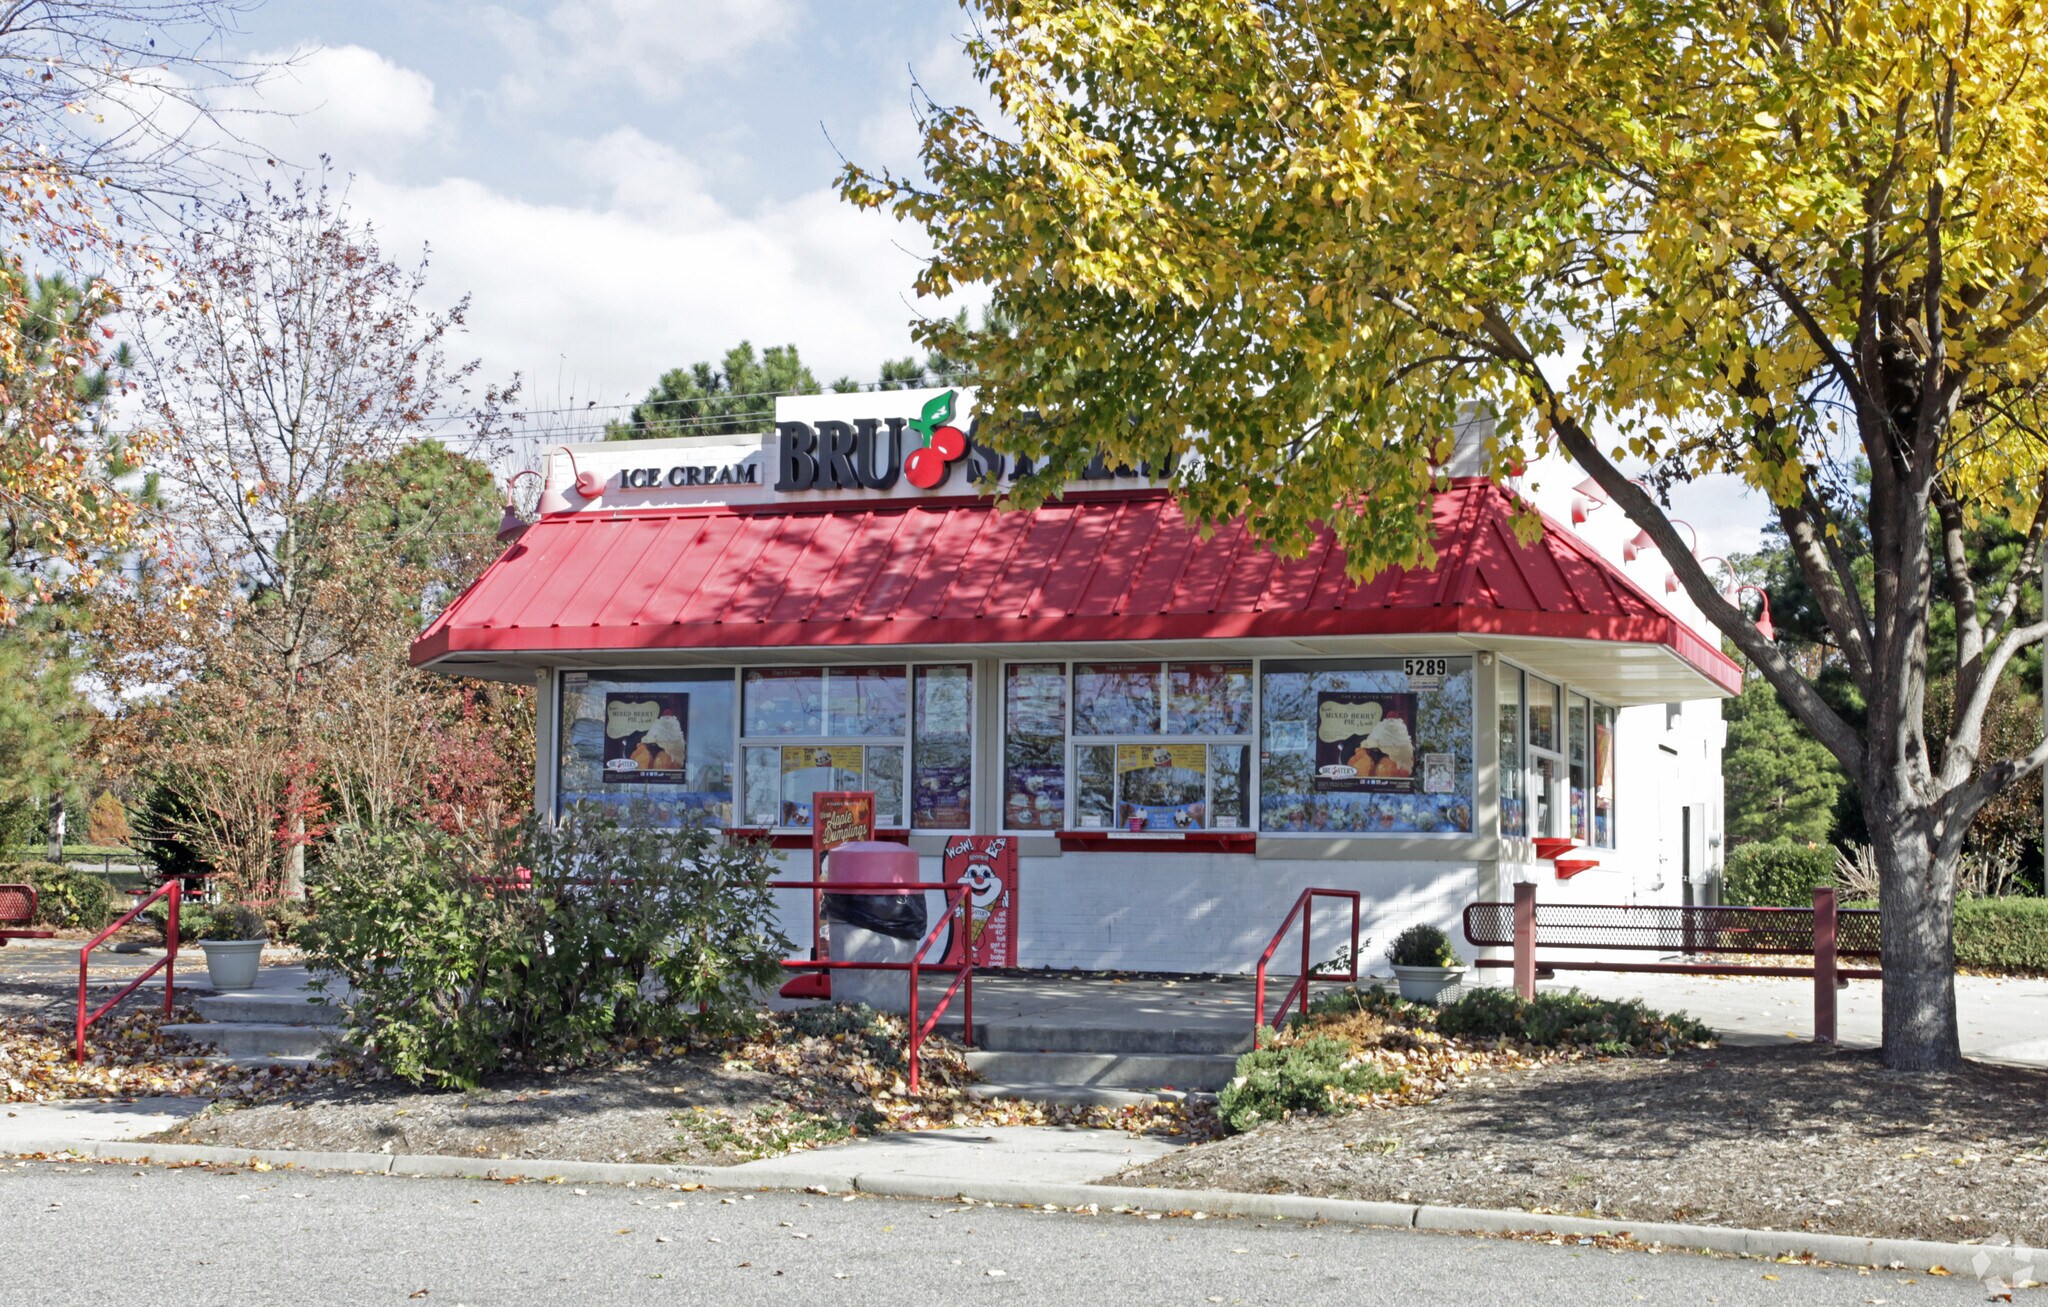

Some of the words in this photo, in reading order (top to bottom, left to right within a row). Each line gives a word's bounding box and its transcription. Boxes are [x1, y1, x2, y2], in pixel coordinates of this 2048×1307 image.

[620, 467, 662, 489] ICE
[668, 463, 757, 487] CREAM
[1404, 659, 1446, 676] 5289
[826, 810, 852, 829] Apple
[823, 824, 868, 844] Dumplings
